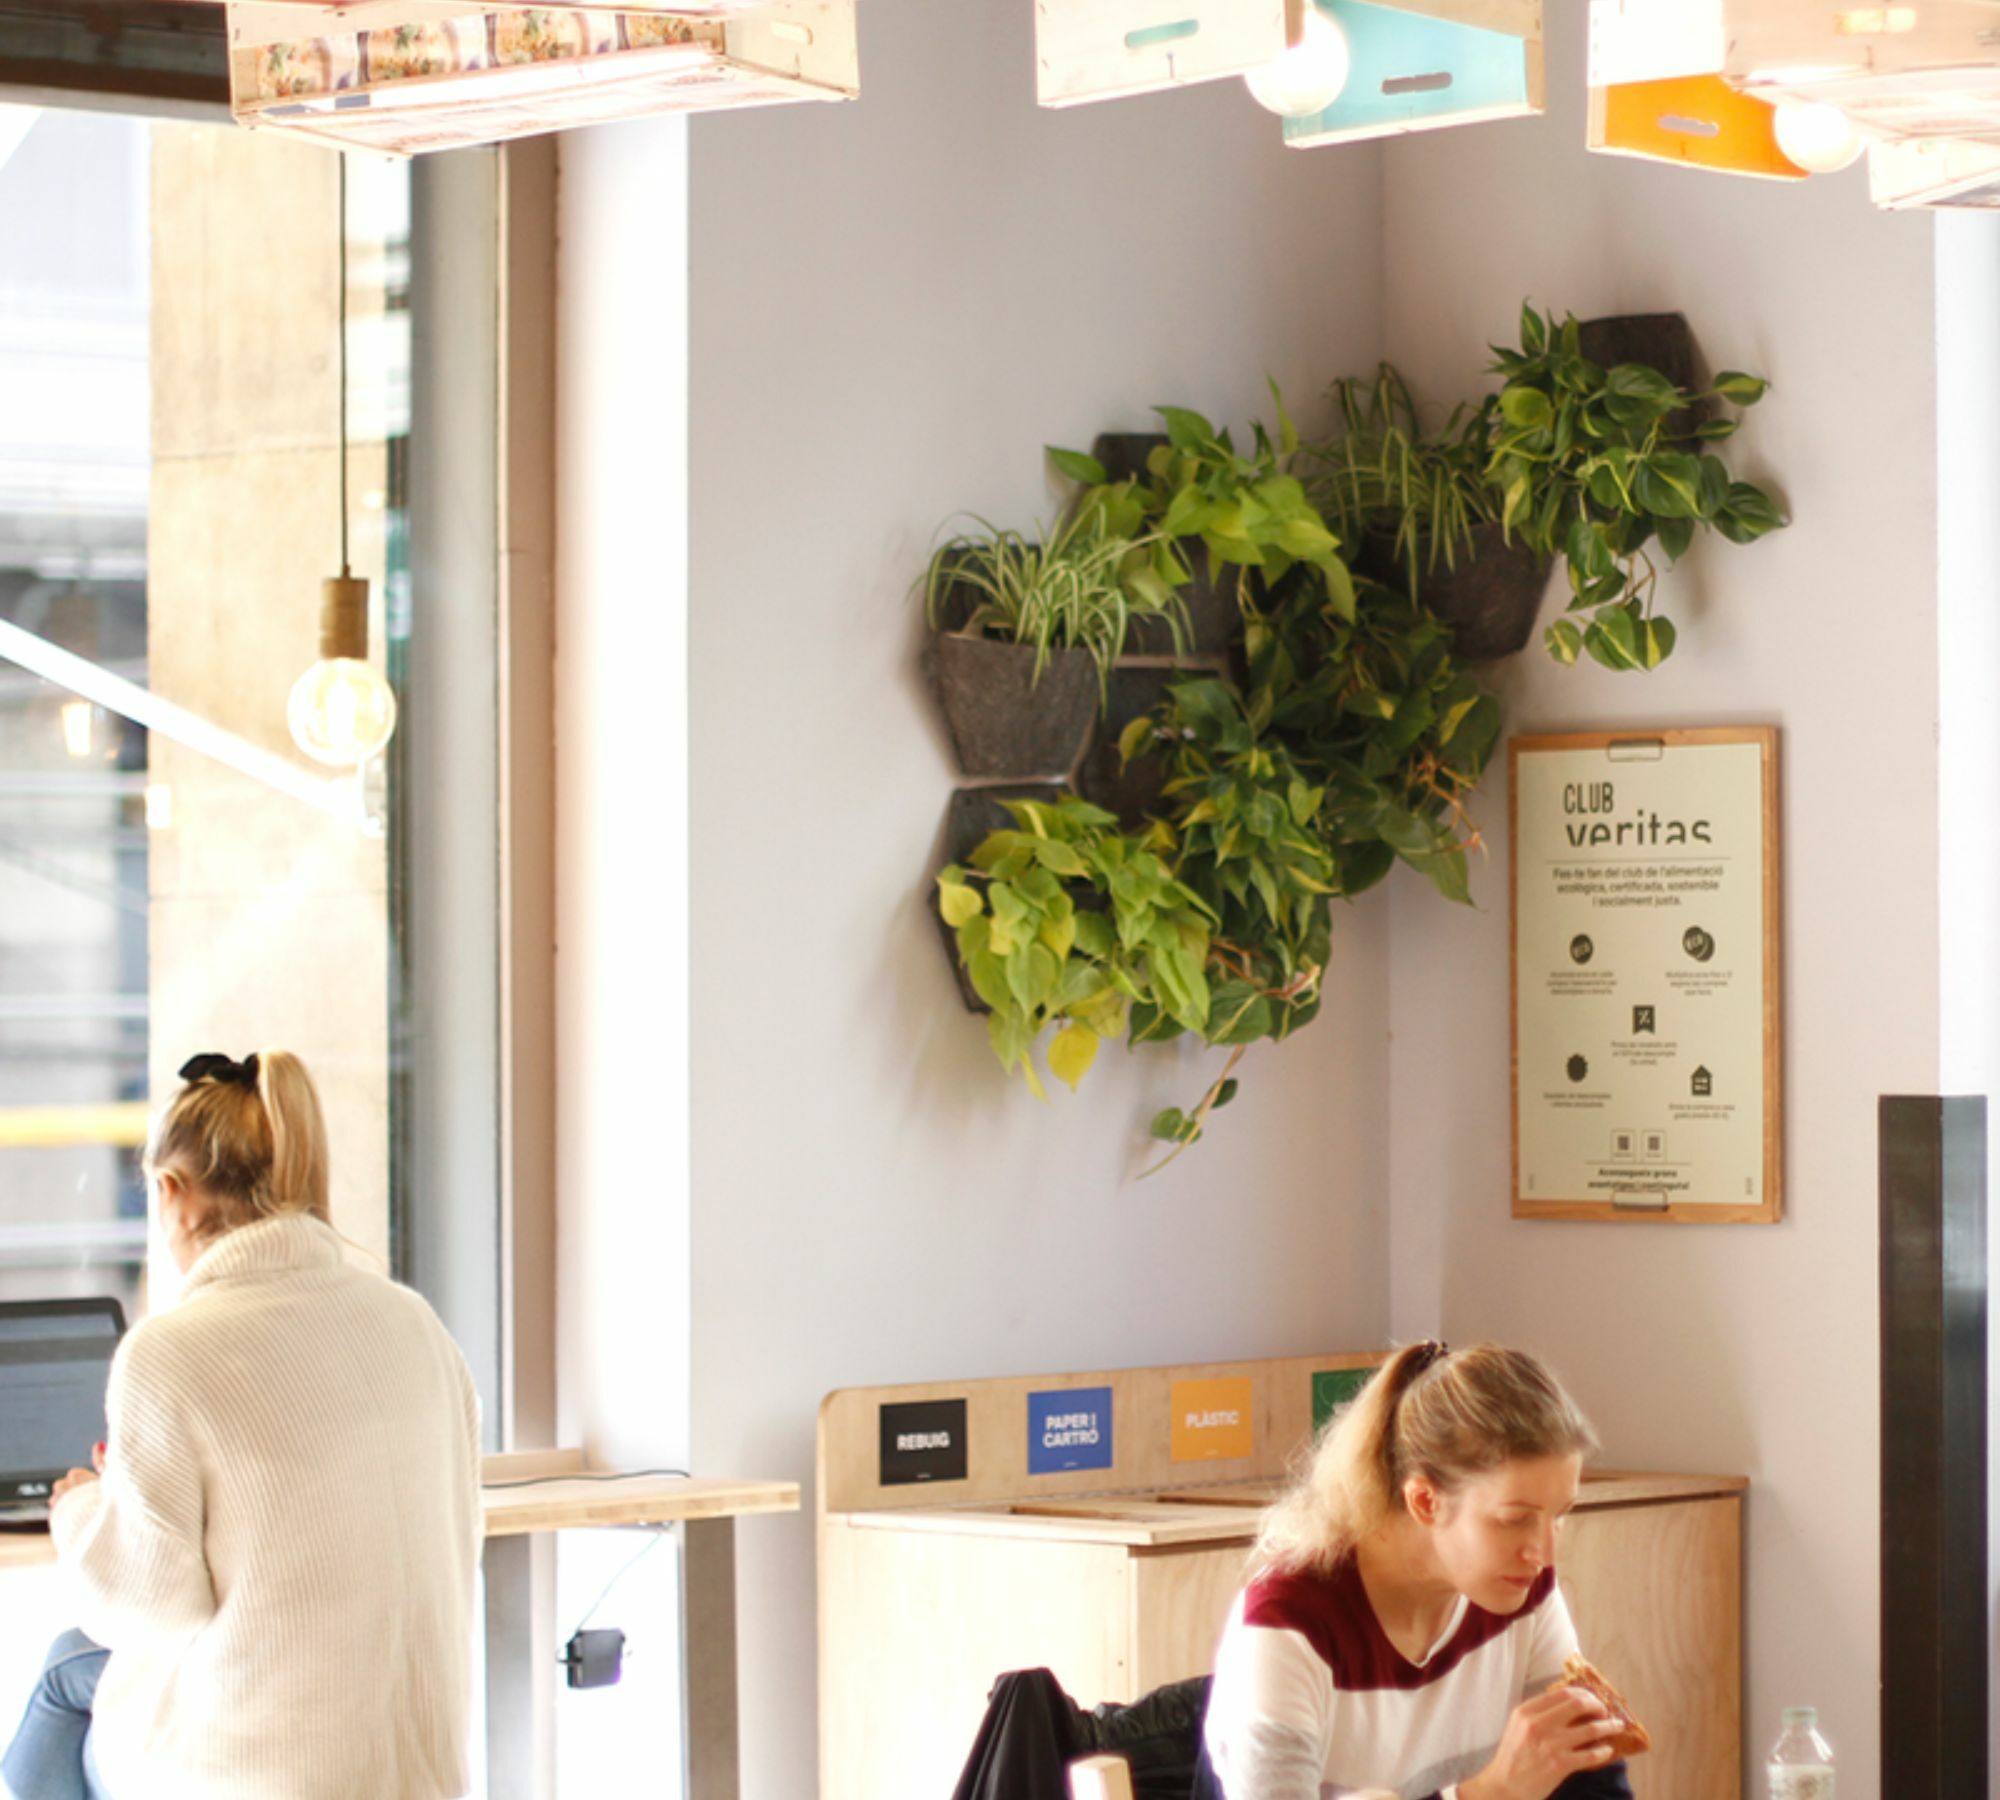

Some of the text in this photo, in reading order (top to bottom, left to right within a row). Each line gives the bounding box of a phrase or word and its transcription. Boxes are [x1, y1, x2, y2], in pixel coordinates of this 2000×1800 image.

[1563, 782, 1614, 814] CLUB
[1566, 809, 1712, 847] veritas
[1587, 867, 1602, 879] fan
[1604, 867, 1620, 879] del
[1622, 867, 1643, 878] club
[1646, 866, 1658, 878] de
[1667, 880, 1719, 891] sostenible
[1046, 1413, 1089, 1431] PAPER
[1185, 1409, 1239, 1429] PLÀSTIC
[897, 1431, 950, 1451] REBUIG
[1043, 1427, 1099, 1448] CARTRÓ
